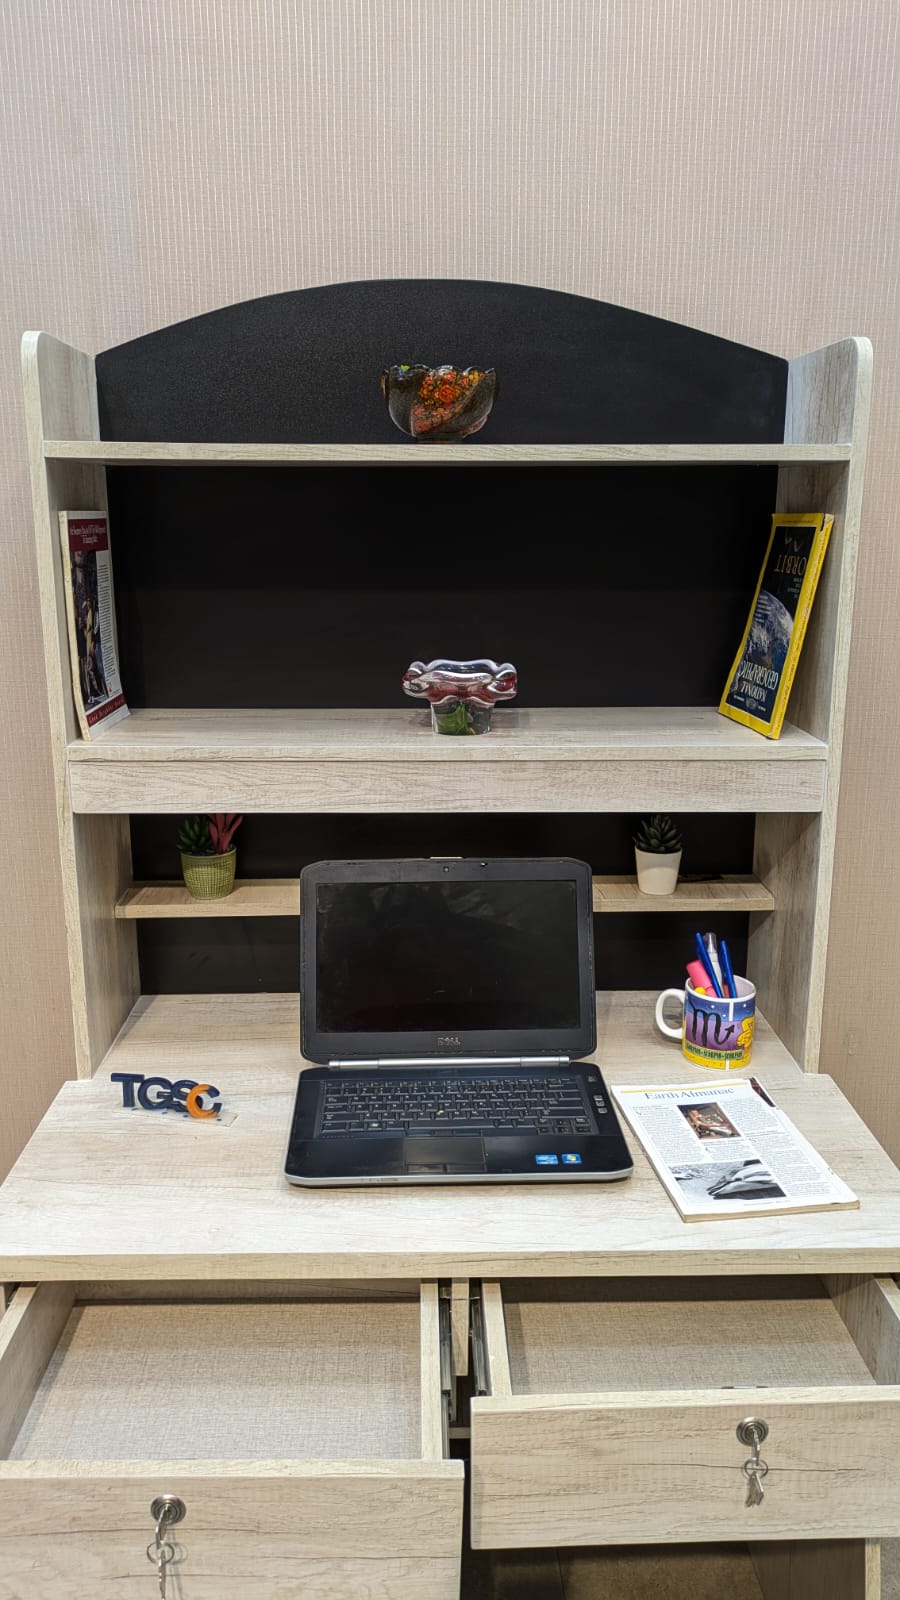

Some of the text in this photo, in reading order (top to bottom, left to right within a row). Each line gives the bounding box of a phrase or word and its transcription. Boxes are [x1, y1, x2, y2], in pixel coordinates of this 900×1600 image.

[774, 554, 808, 576] ORBIT
[738, 660, 779, 690] GEOGRAPHIC
[741, 680, 767, 702] NATIONAL
[110, 1072, 223, 1119] TGSC
[644, 1087, 736, 1100] Earth Almanac
